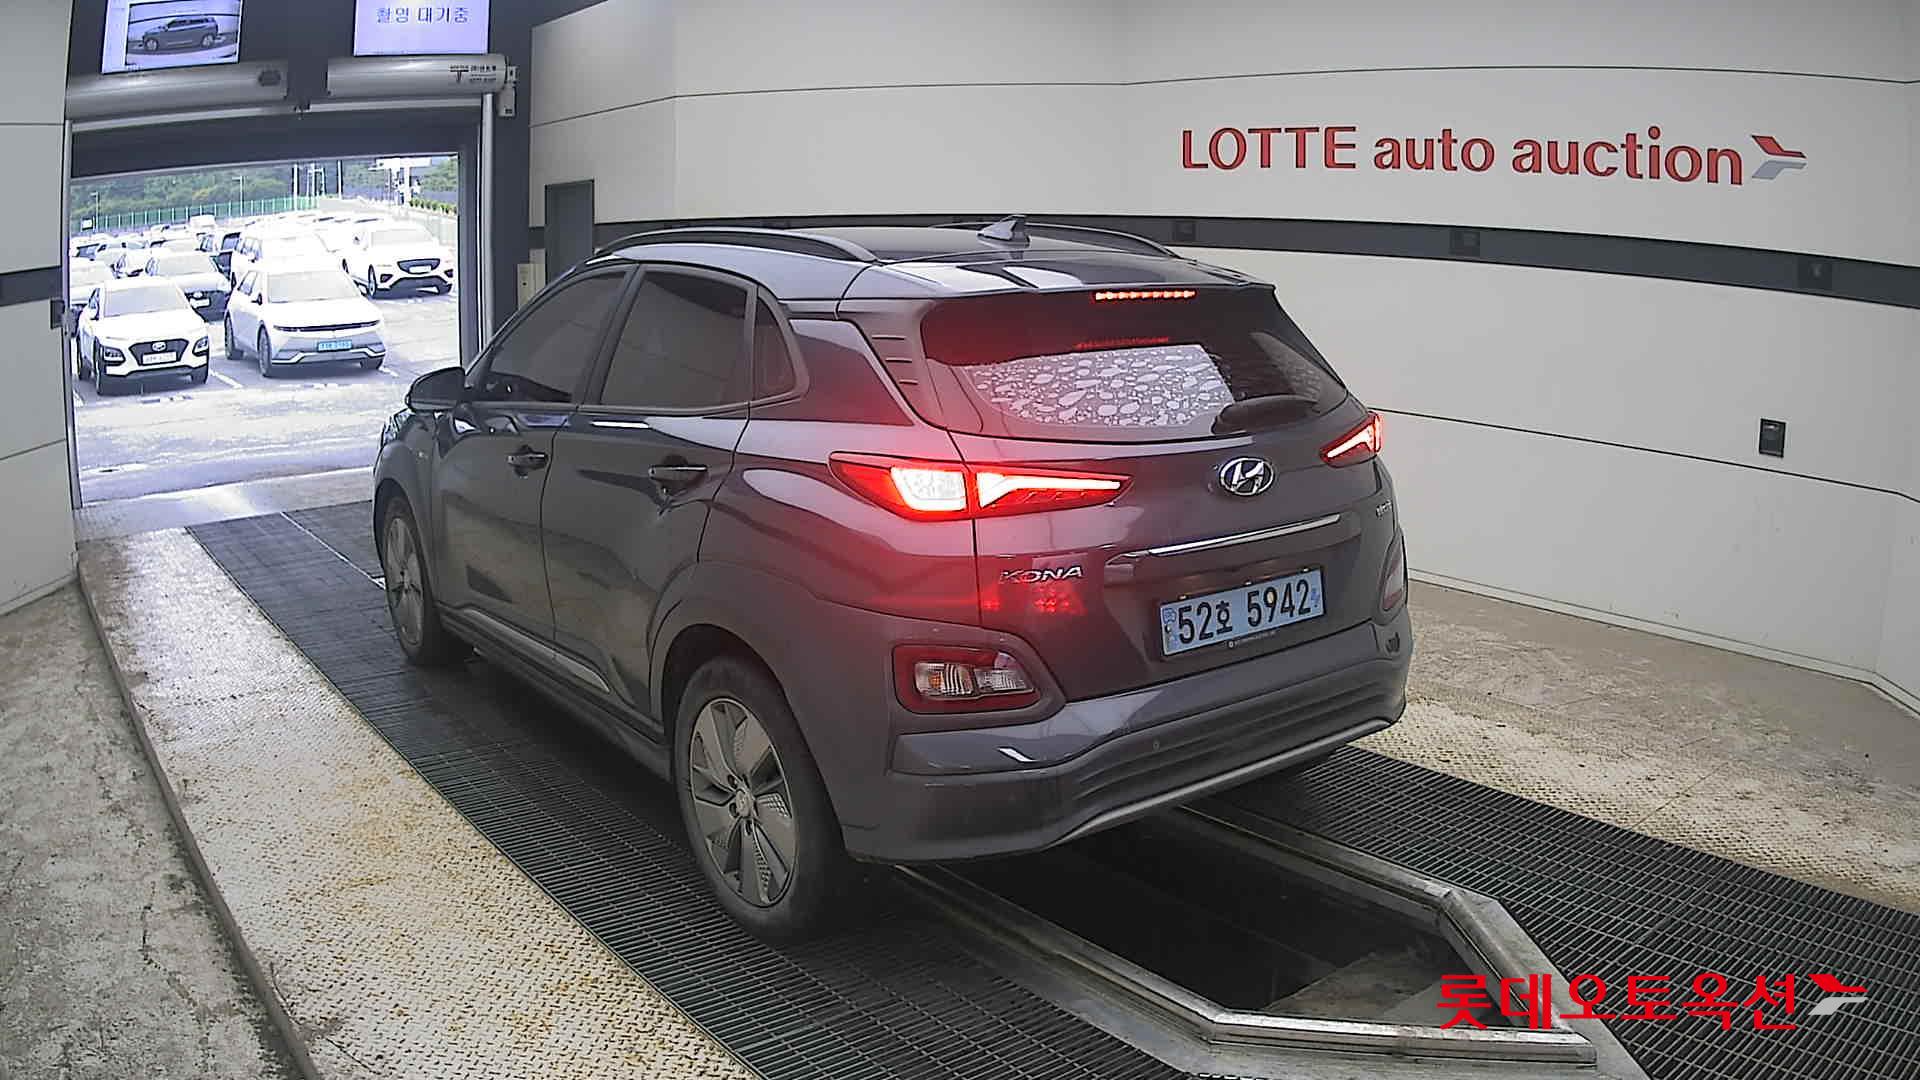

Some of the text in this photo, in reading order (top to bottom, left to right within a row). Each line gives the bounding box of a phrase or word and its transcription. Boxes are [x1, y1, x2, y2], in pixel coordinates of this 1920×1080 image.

[1182, 126, 1743, 185] LOTTE auto auction
[1001, 566, 1083, 584] KONA
[1178, 579, 1312, 644] 52호 5942
